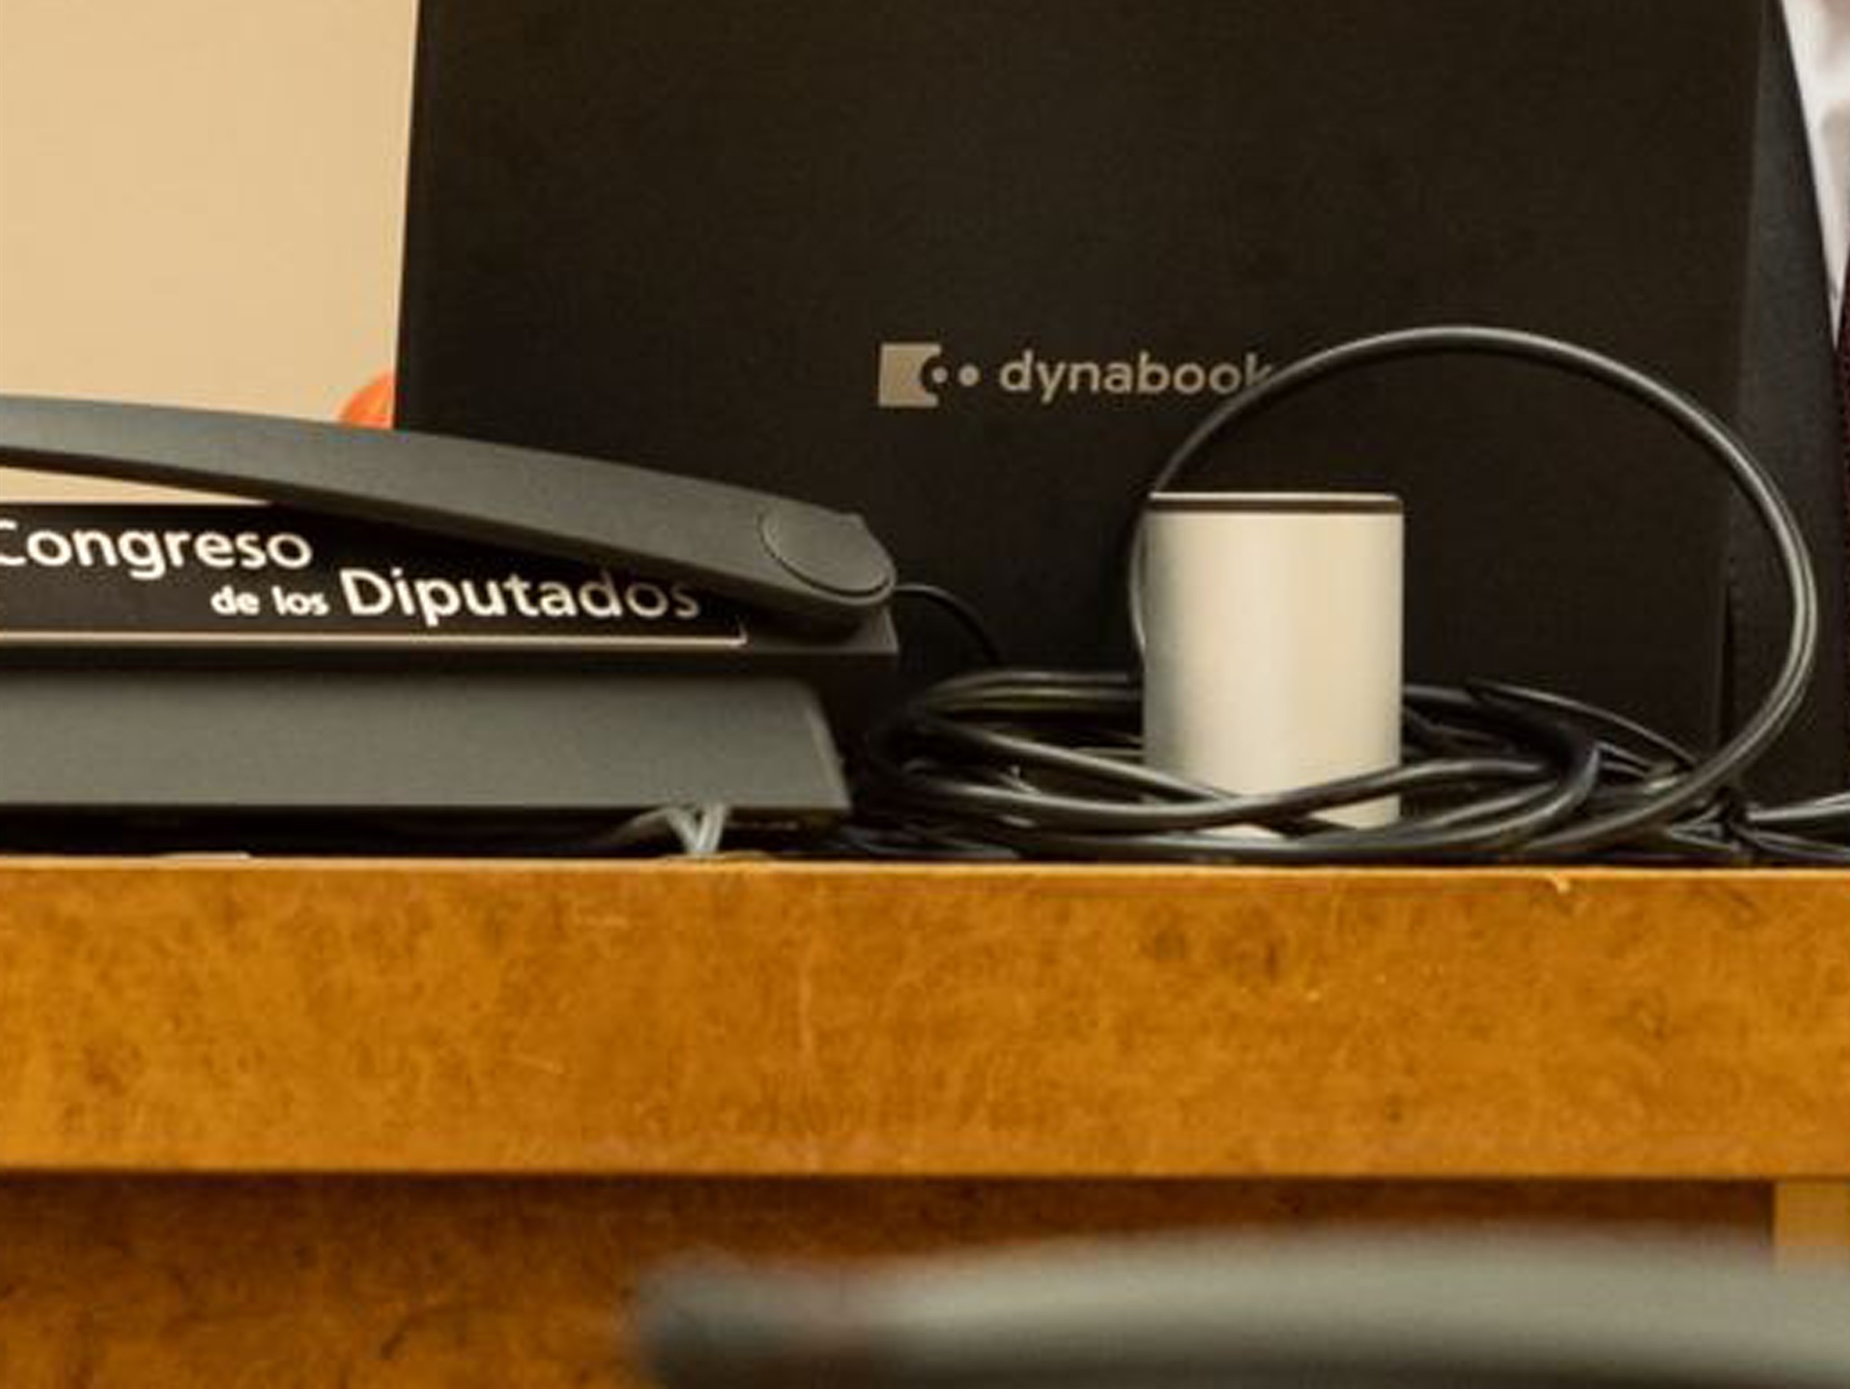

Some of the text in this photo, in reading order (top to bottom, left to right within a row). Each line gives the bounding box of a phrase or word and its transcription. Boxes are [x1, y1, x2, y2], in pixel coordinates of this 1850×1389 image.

[999, 349, 1273, 403] dynabook
[0, 519, 313, 579] Congreso
[211, 567, 700, 627] de los Diputados
